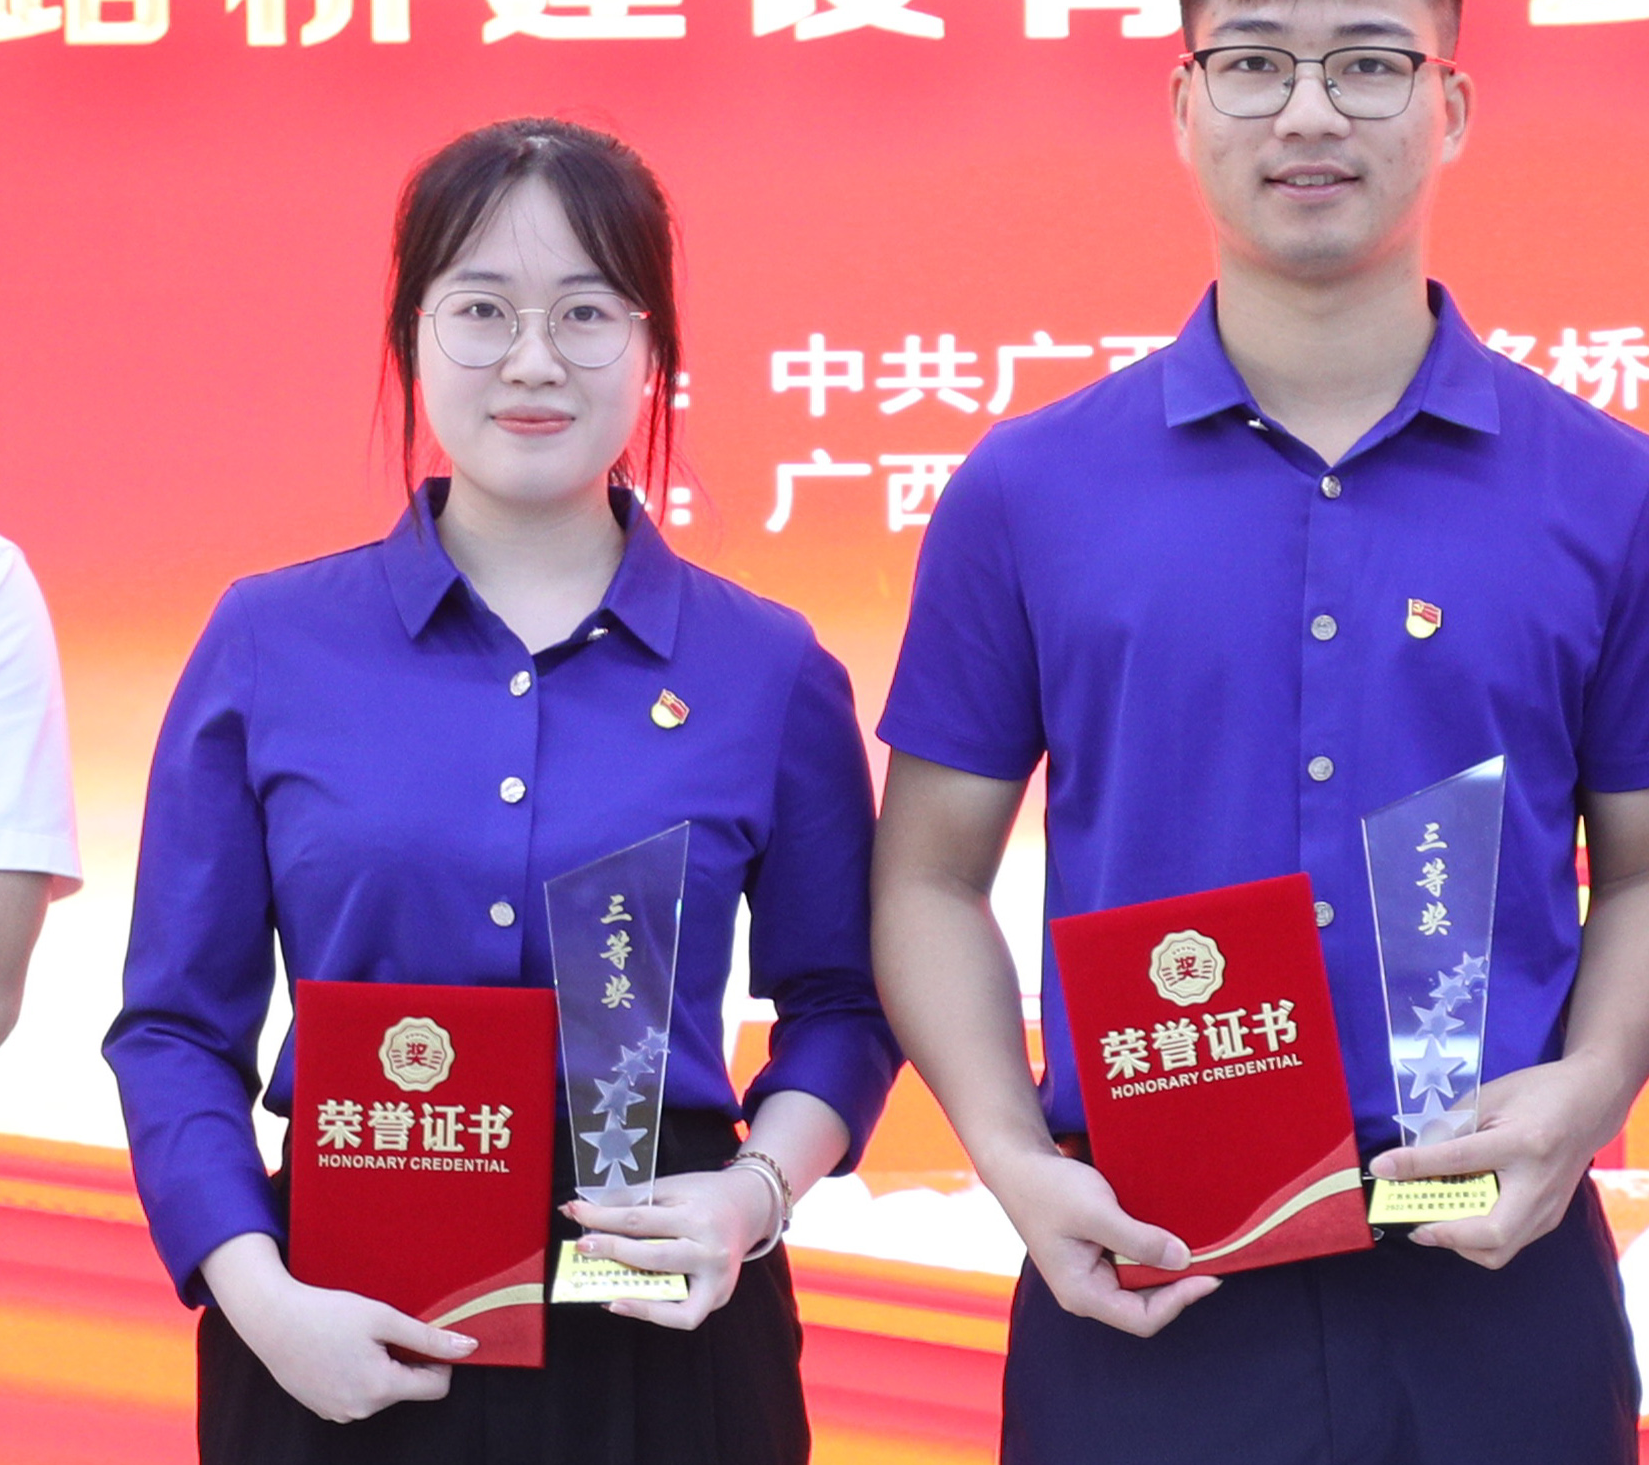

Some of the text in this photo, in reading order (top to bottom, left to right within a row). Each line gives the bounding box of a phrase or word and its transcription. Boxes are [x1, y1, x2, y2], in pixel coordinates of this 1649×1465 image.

[1414, 822, 1452, 937] 三等奖
[599, 893, 636, 1010] 三等奖
[1175, 955, 1199, 981] 奖
[406, 1042, 428, 1066] 奖
[1100, 999, 1297, 1080] 荣誉证书
[1111, 1053, 1302, 1100] HONORARY CREDENTIAL
[317, 1098, 514, 1155] 荣誉证书
[318, 1154, 510, 1173] HONORARY CREDENTIAL
